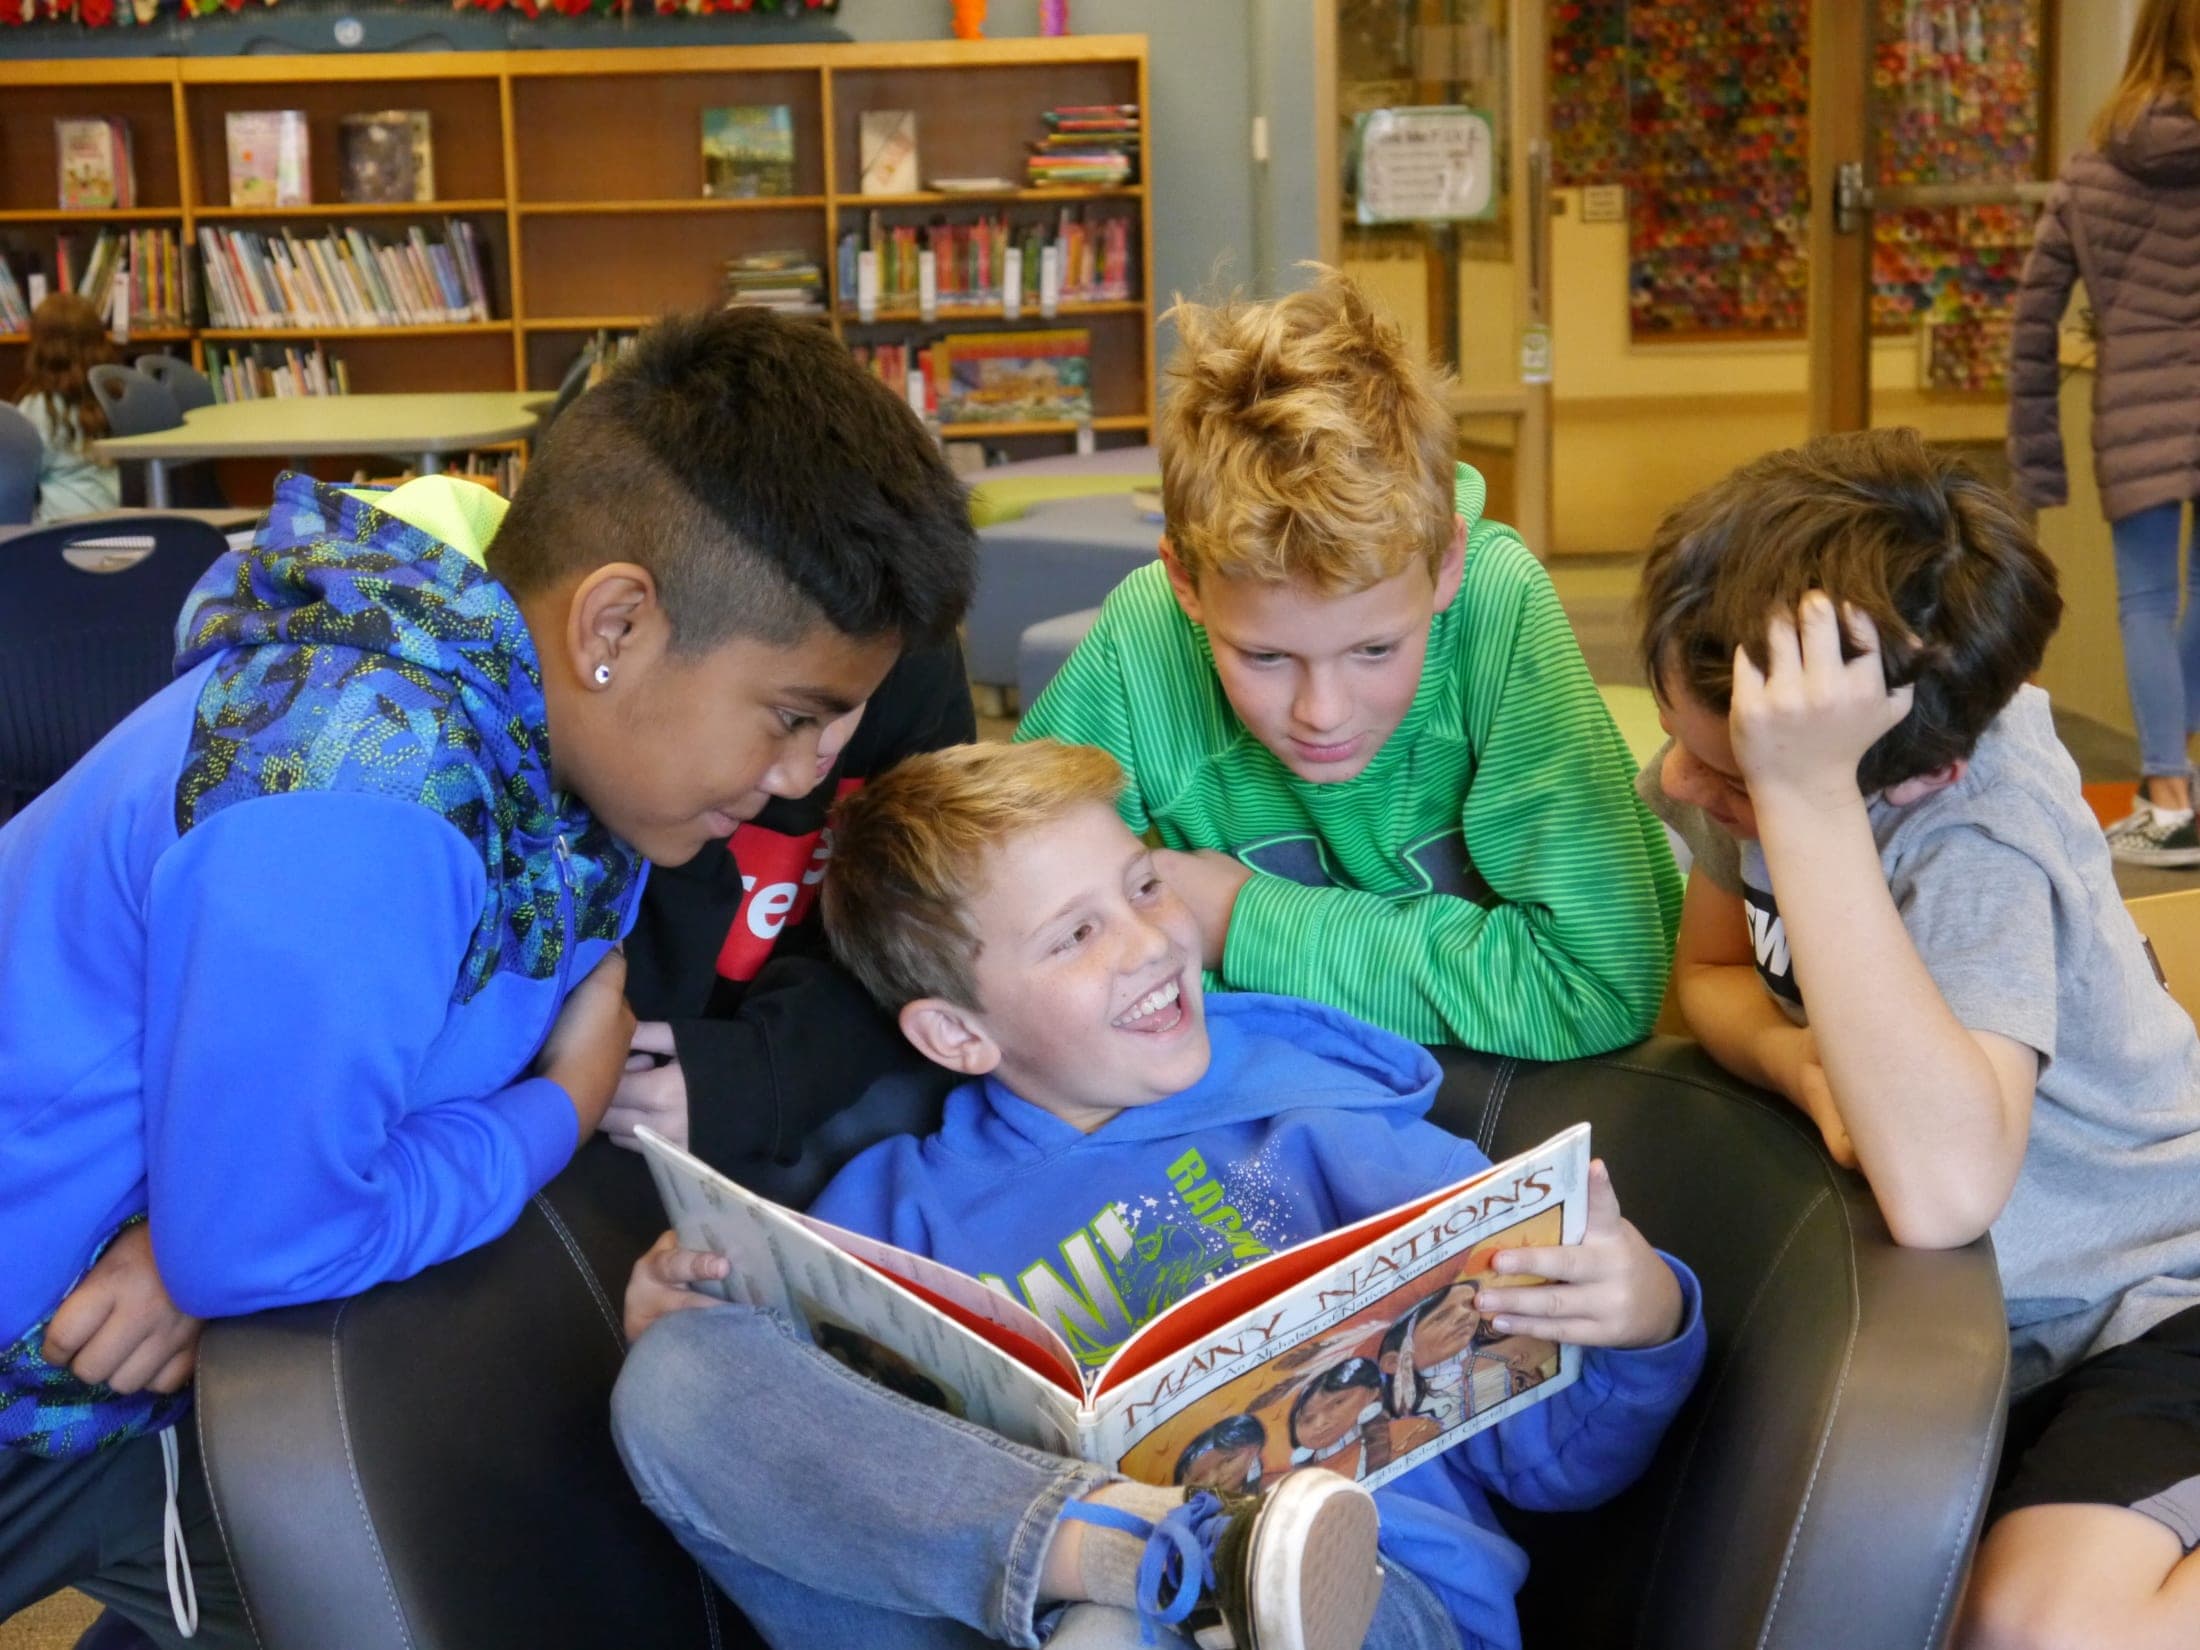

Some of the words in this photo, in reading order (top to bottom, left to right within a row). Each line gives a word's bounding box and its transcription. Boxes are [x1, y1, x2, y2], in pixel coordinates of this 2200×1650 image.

[1121, 1308, 1287, 1434] MANY
[1312, 1166, 1553, 1315] NATIONS
[1250, 1324, 1319, 1365] Alphabet
[1341, 1286, 1388, 1317] Native
